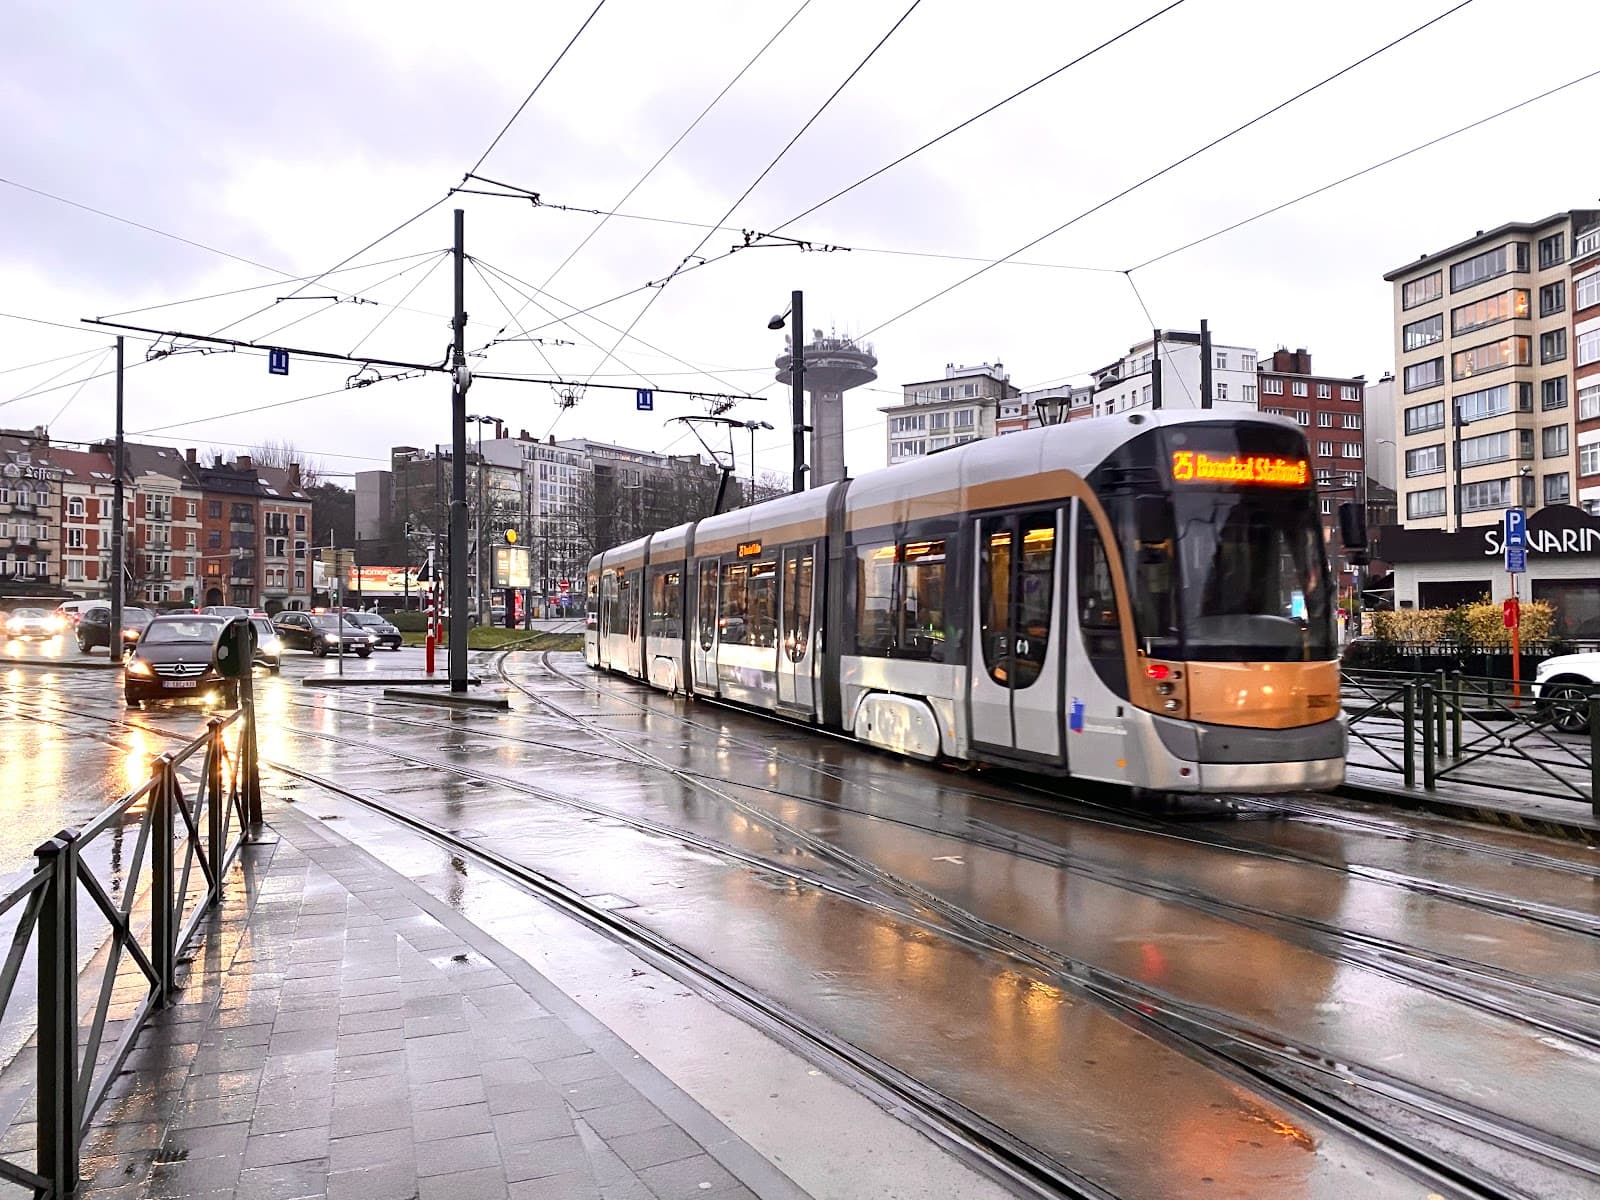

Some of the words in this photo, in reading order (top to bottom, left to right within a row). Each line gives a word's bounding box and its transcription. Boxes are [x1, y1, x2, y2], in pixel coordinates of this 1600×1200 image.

[24, 465, 52, 480] Leffe
[1173, 451, 1194, 480] 25
[1509, 512, 1521, 532] P
[1484, 527, 1600, 555] SVARIN
